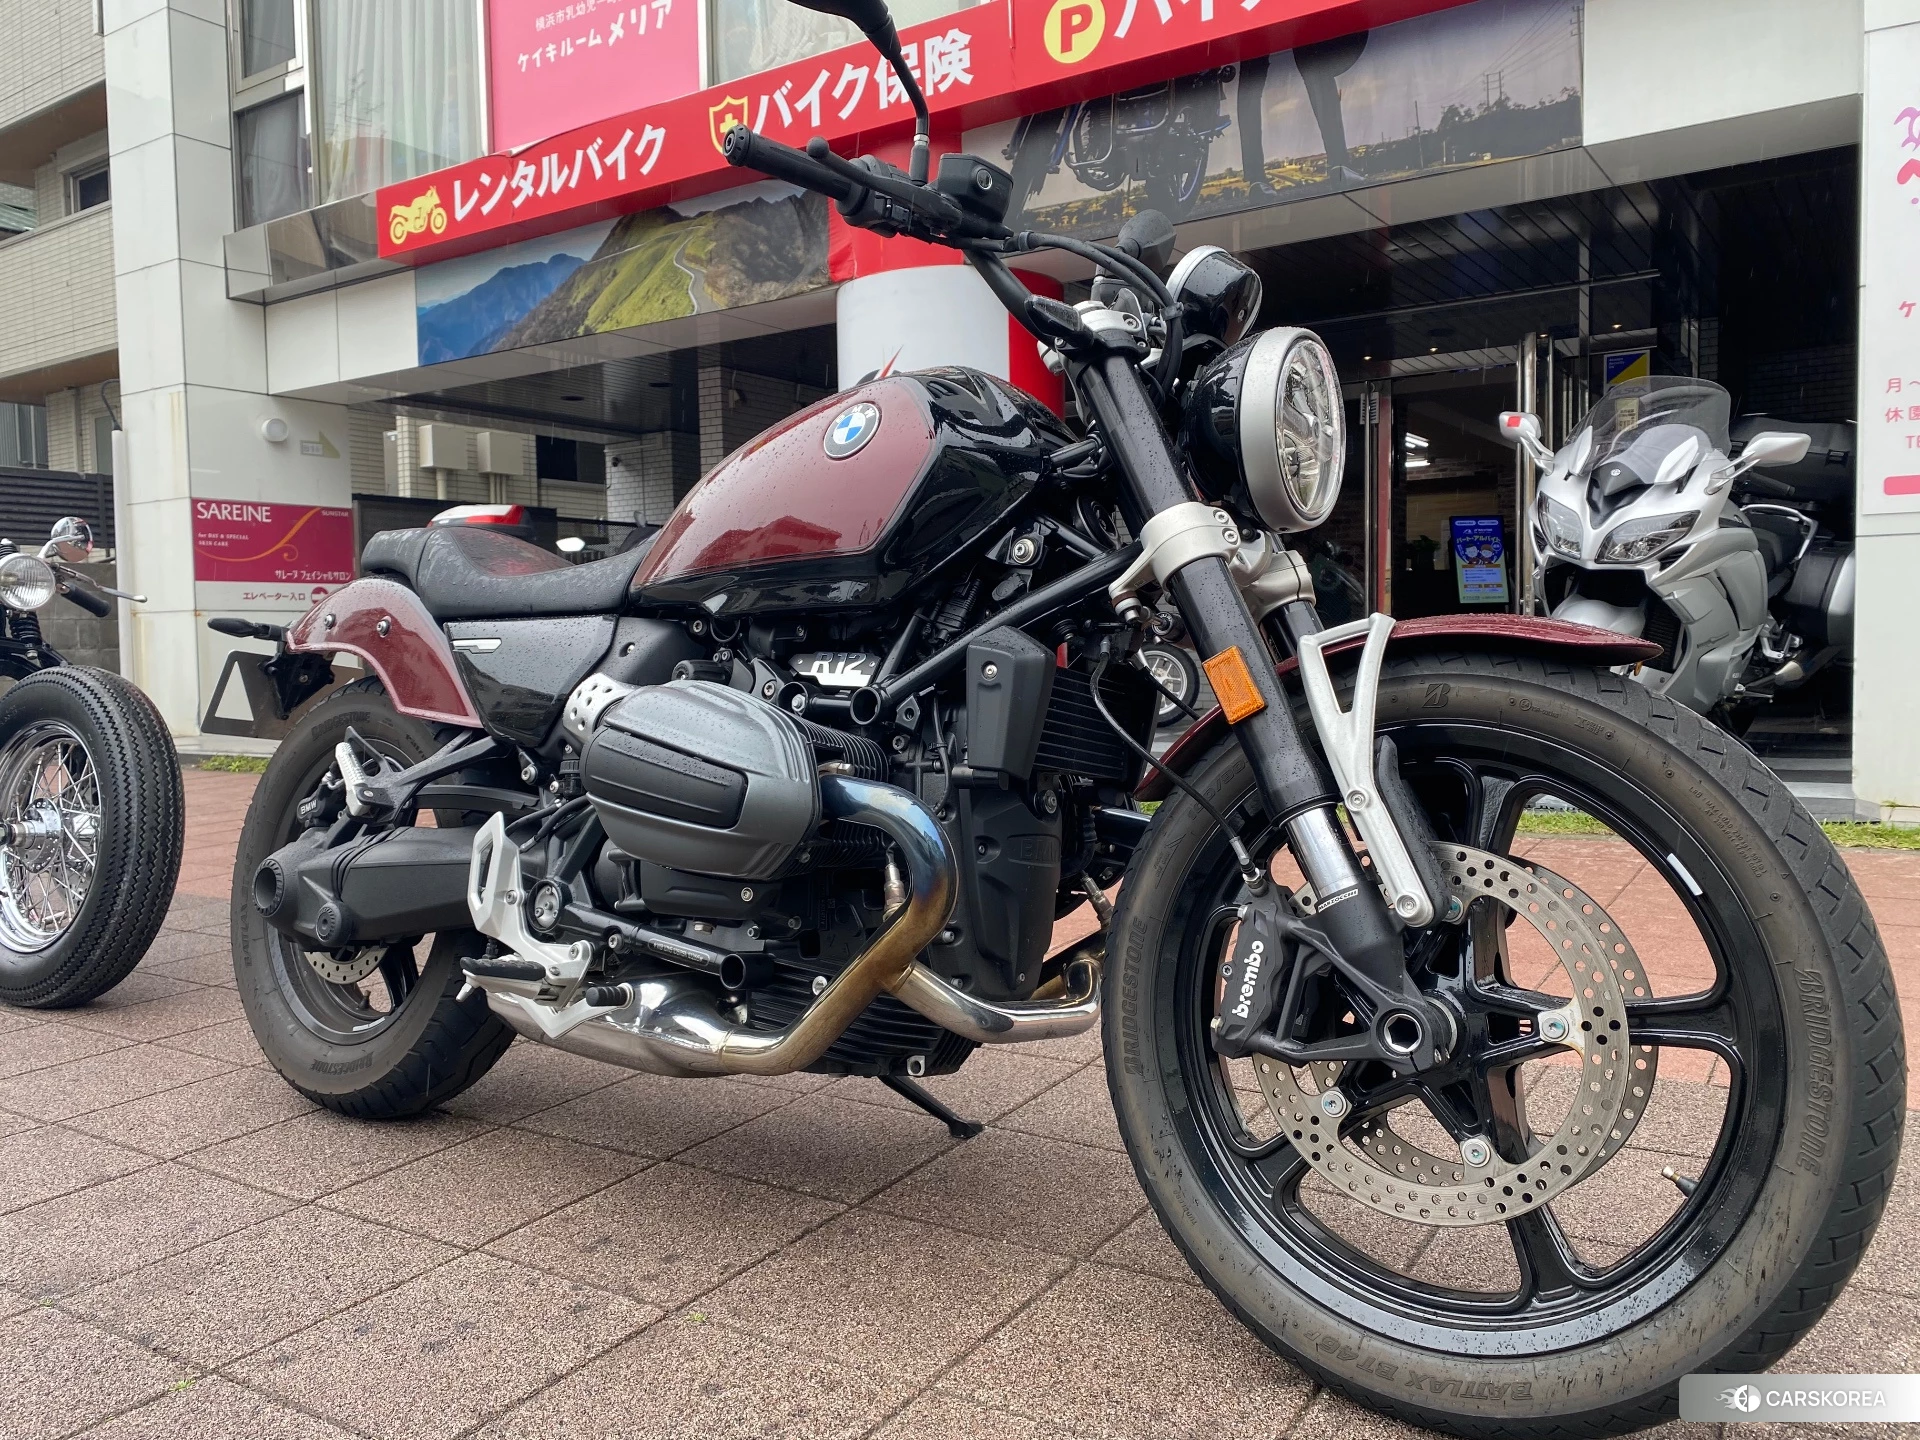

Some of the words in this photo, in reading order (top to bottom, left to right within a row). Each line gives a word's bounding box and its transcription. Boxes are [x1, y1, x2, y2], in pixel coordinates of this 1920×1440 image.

[535, 0, 621, 31] 横浜市乳幼児
[517, 28, 602, 72] ケイキルーム
[608, 0, 673, 46] メリア
[753, 28, 973, 135] バイク保険
[453, 124, 666, 222] レンタルバイク
[196, 501, 272, 522] SAREINE
[275, 569, 298, 579] サレーヌ
[300, 570, 352, 581] フェイシャルサロン
[243, 592, 306, 601] エレベーター入口
[300, 799, 317, 815] BMW
[1318, 888, 1358, 912] MARZOCCHI
[1231, 940, 1264, 1019] brembo
[1122, 916, 1148, 1077] BRIDGESTONE
[1794, 968, 1834, 1176] BRIDGESTONE
[1404, 1369, 1534, 1401] BATTLAX
